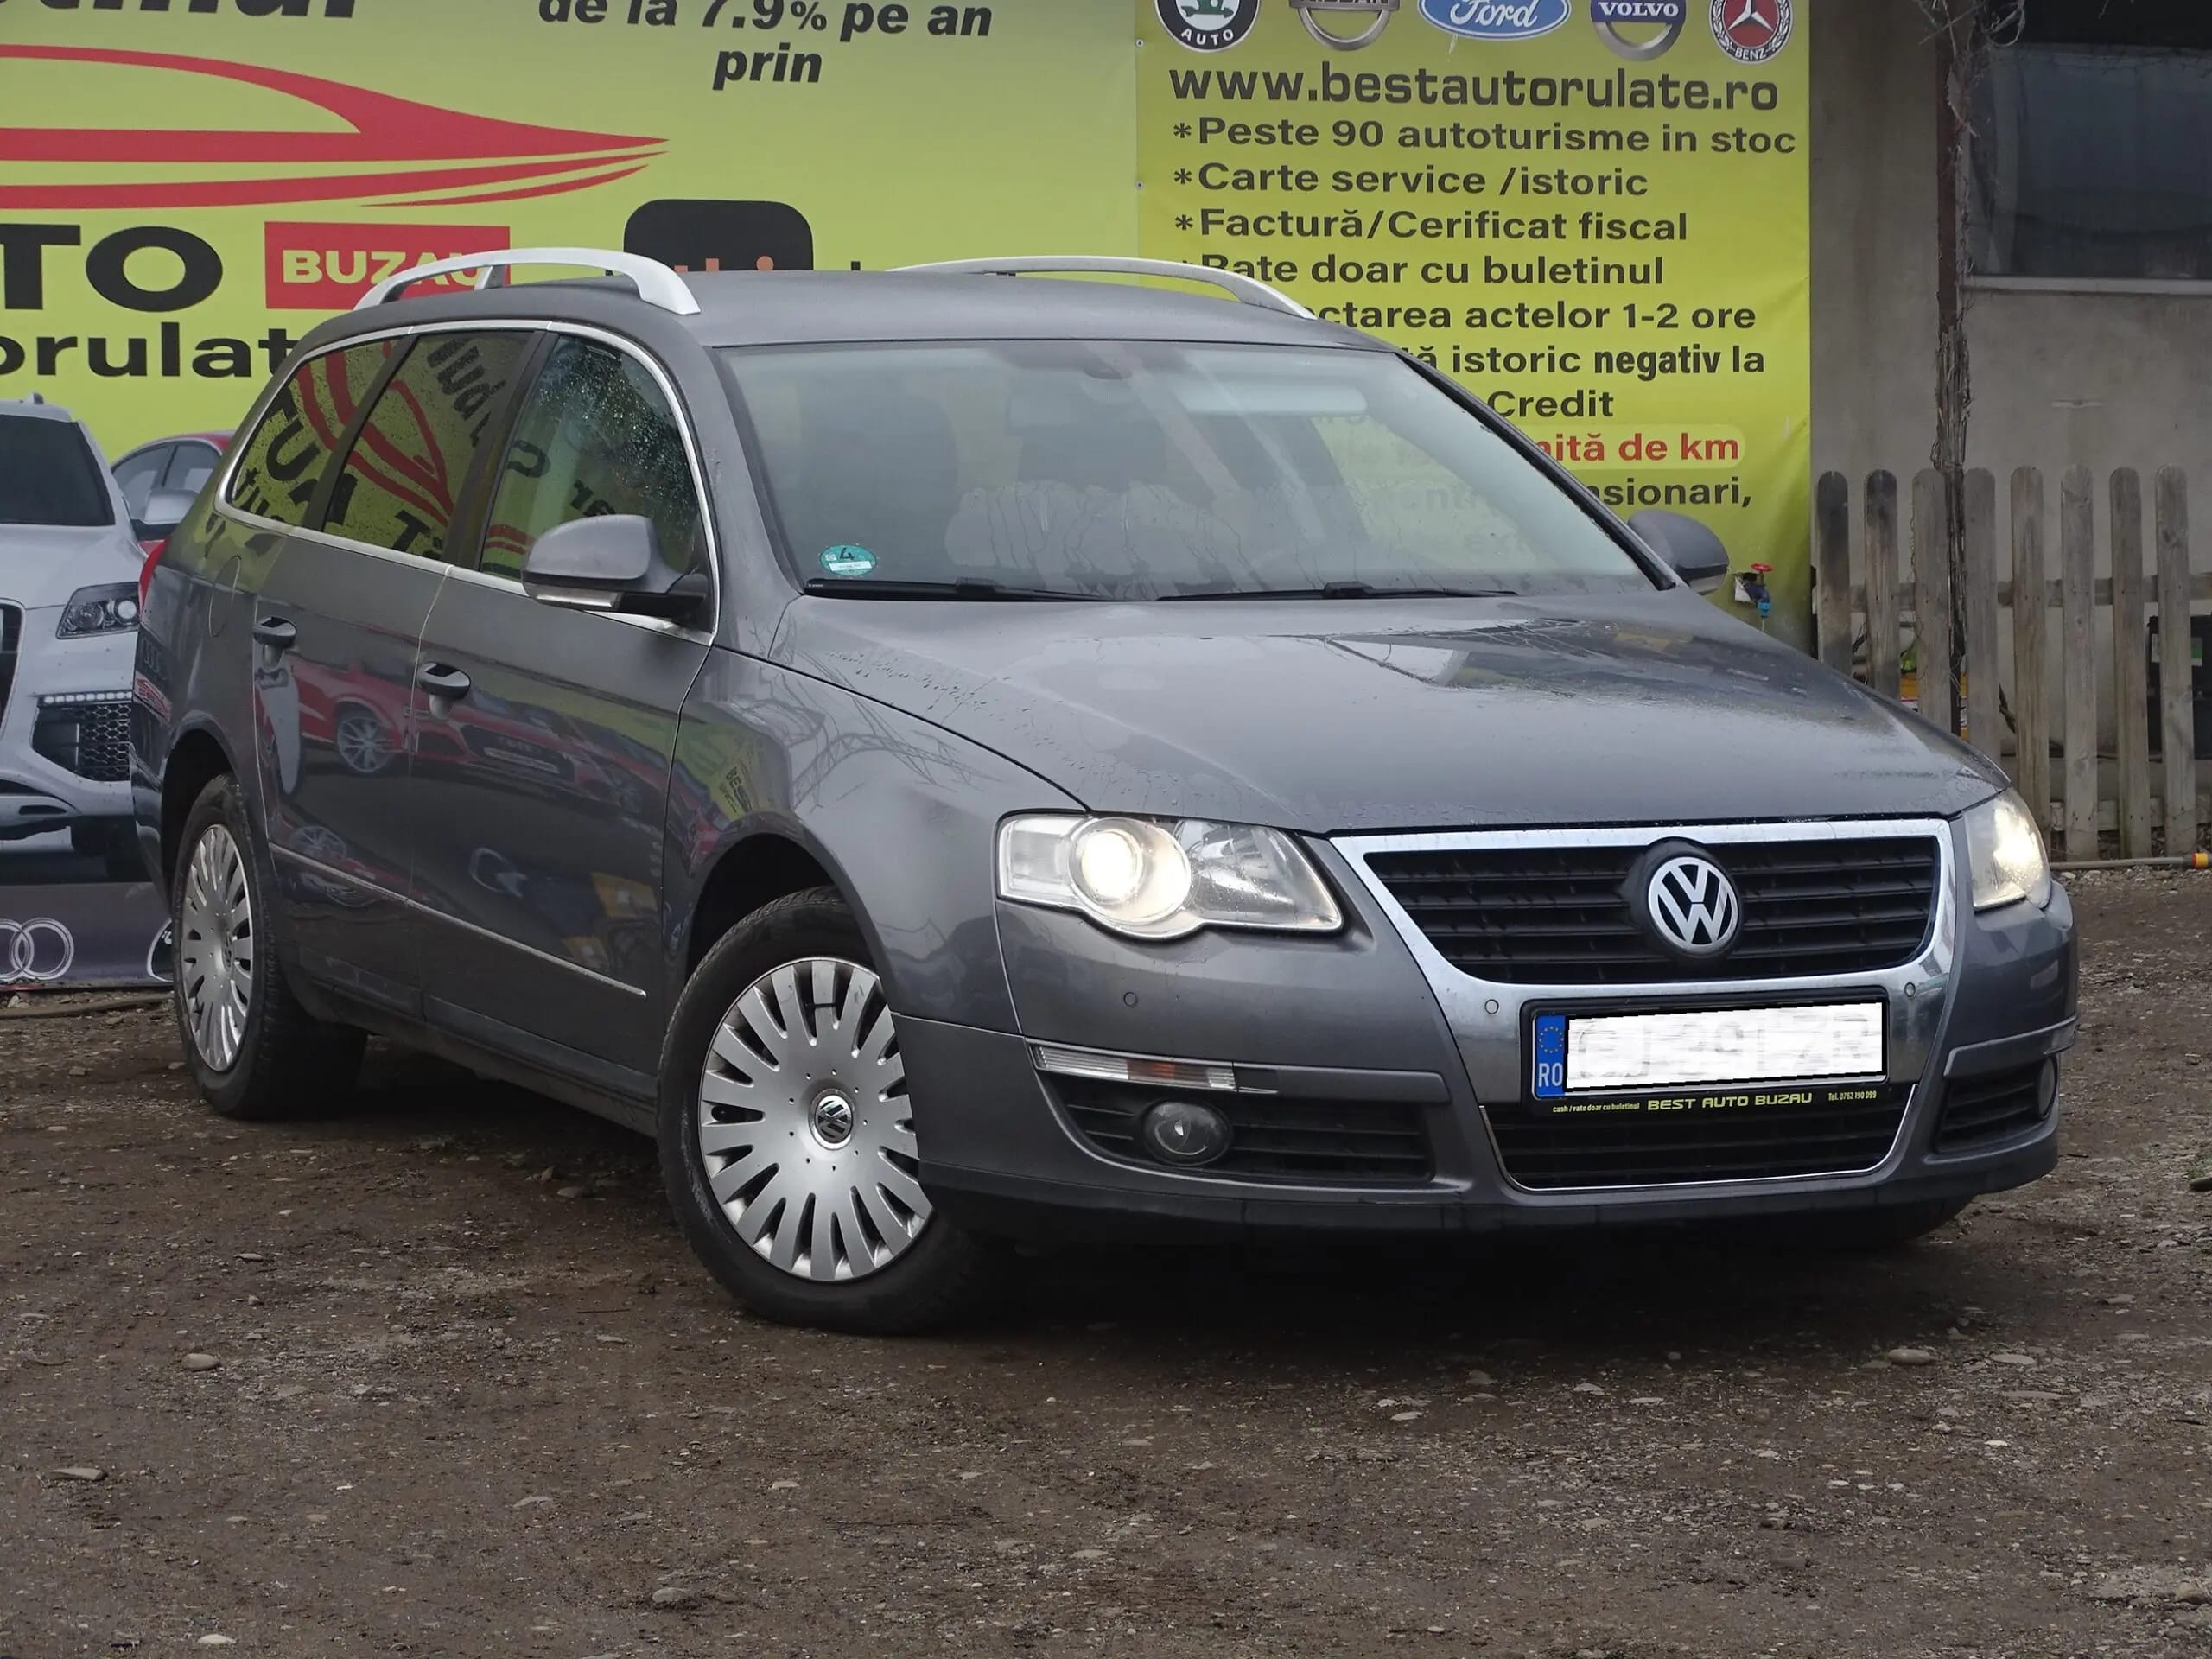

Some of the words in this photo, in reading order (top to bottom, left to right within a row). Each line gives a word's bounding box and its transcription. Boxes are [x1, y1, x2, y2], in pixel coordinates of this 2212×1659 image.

[538, 0, 608, 24] de
[626, 0, 678, 27] la
[839, 3, 910, 43] pe
[926, 5, 993, 37] an
[1449, 0, 1539, 28] Ford
[1600, 1, 1680, 17] VOLVO
[1180, 29, 1235, 46] AUTO
[712, 41, 823, 92] prin
[1734, 48, 1768, 61] BENZ
[1168, 60, 1778, 110] www.bestautorulate.ro
[1332, 119, 1384, 148] 90
[1397, 121, 1649, 151] autoturisme
[1662, 124, 1698, 153] in
[1710, 127, 1796, 154] stoc
[1331, 164, 1486, 194] service
[1498, 165, 1649, 196] /istoric
[1577, 211, 1688, 241] fiscal
[1310, 253, 1408, 283] doar
[1421, 260, 1470, 284] cu
[1483, 255, 1665, 285] buletinul
[1303, 301, 1452, 328] ctarea
[1465, 300, 1611, 329] actelor
[1623, 302, 1680, 329] 1-2
[1690, 306, 1757, 329] ore
[1452, 345, 1582, 374] istoric
[1593, 343, 1721, 382] negativ
[1732, 345, 1765, 373] la
[1486, 389, 1615, 419] Credit
[1618, 432, 1669, 461] de
[1680, 432, 1739, 461] km
[1538, 1062, 1563, 1088] RO
[1573, 1103, 1586, 1112] rate
[1586, 1103, 1602, 1112] doar
[1647, 1098, 1696, 1111] BEST
[1701, 1095, 1749, 1109] AUTO
[1754, 1092, 1813, 1106] BUZAU
